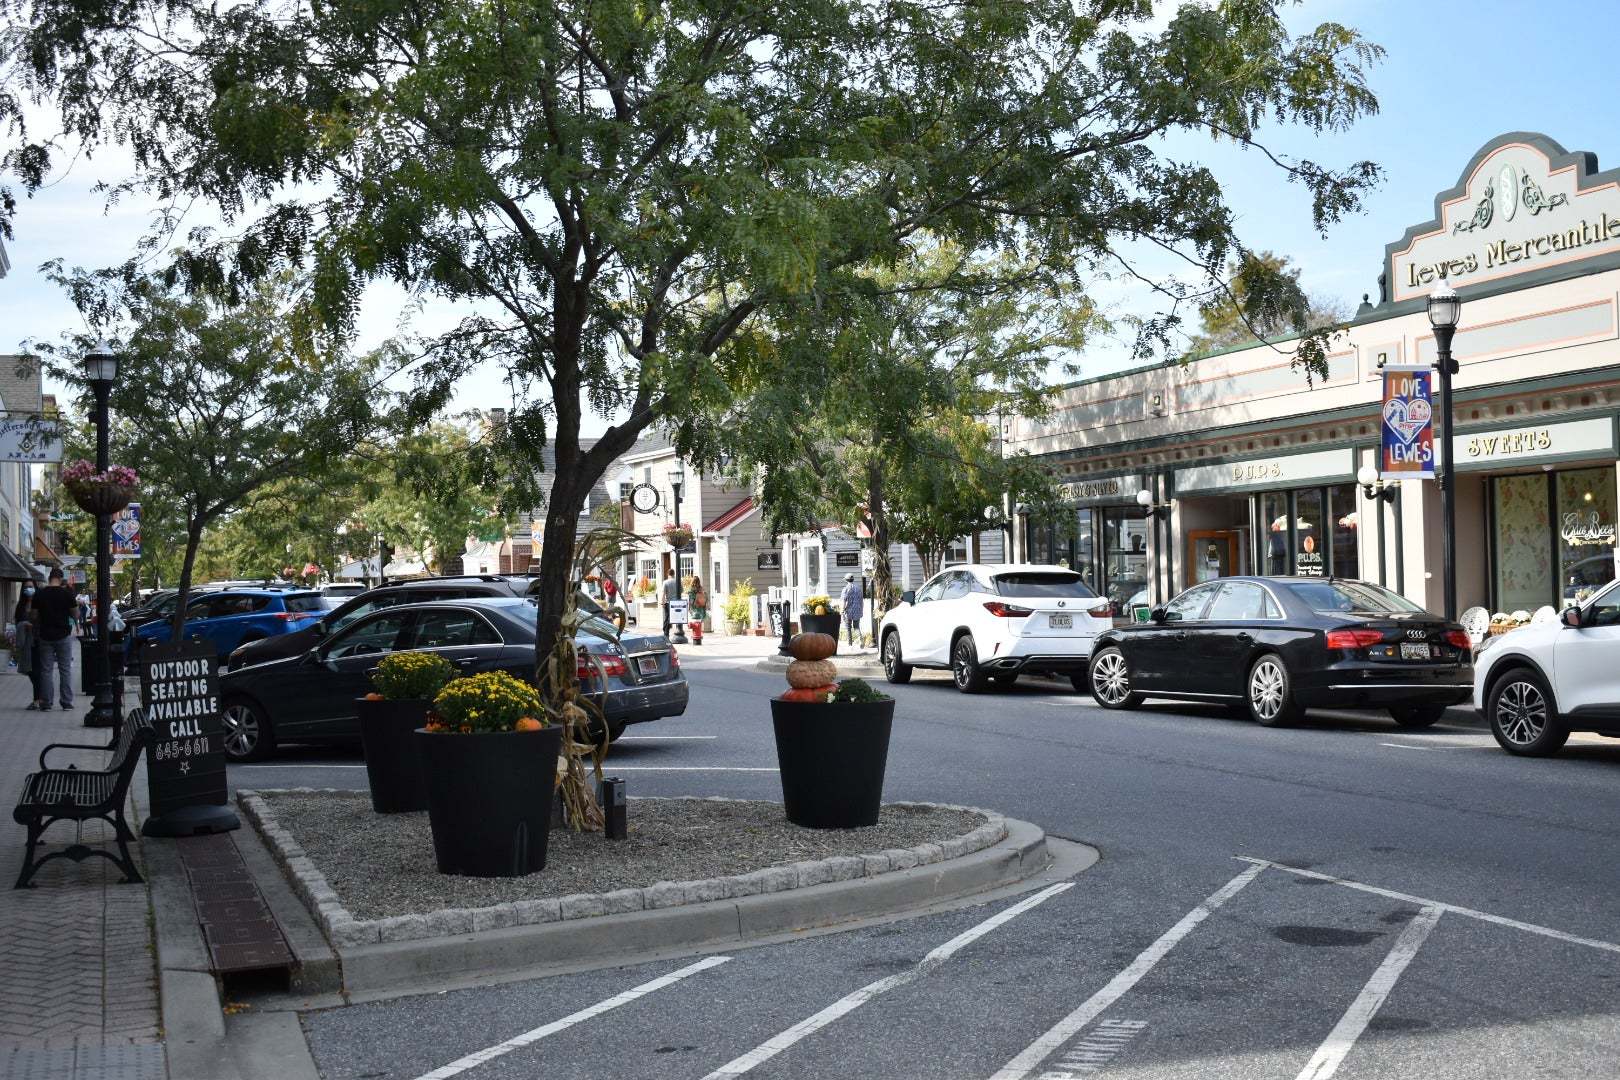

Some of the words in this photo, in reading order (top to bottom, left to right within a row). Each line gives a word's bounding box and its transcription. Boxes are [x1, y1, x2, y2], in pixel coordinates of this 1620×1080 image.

[1407, 254, 1478, 287] Lewes
[1486, 213, 1620, 268] Mercantile
[1392, 378, 1427, 398] LOVE,
[1389, 441, 1432, 464] LEWES
[1468, 430, 1551, 456] SWEETS
[150, 660, 209, 680] OUTDOOR
[149, 697, 217, 720] AVAILABLE
[169, 719, 202, 738] CALL
